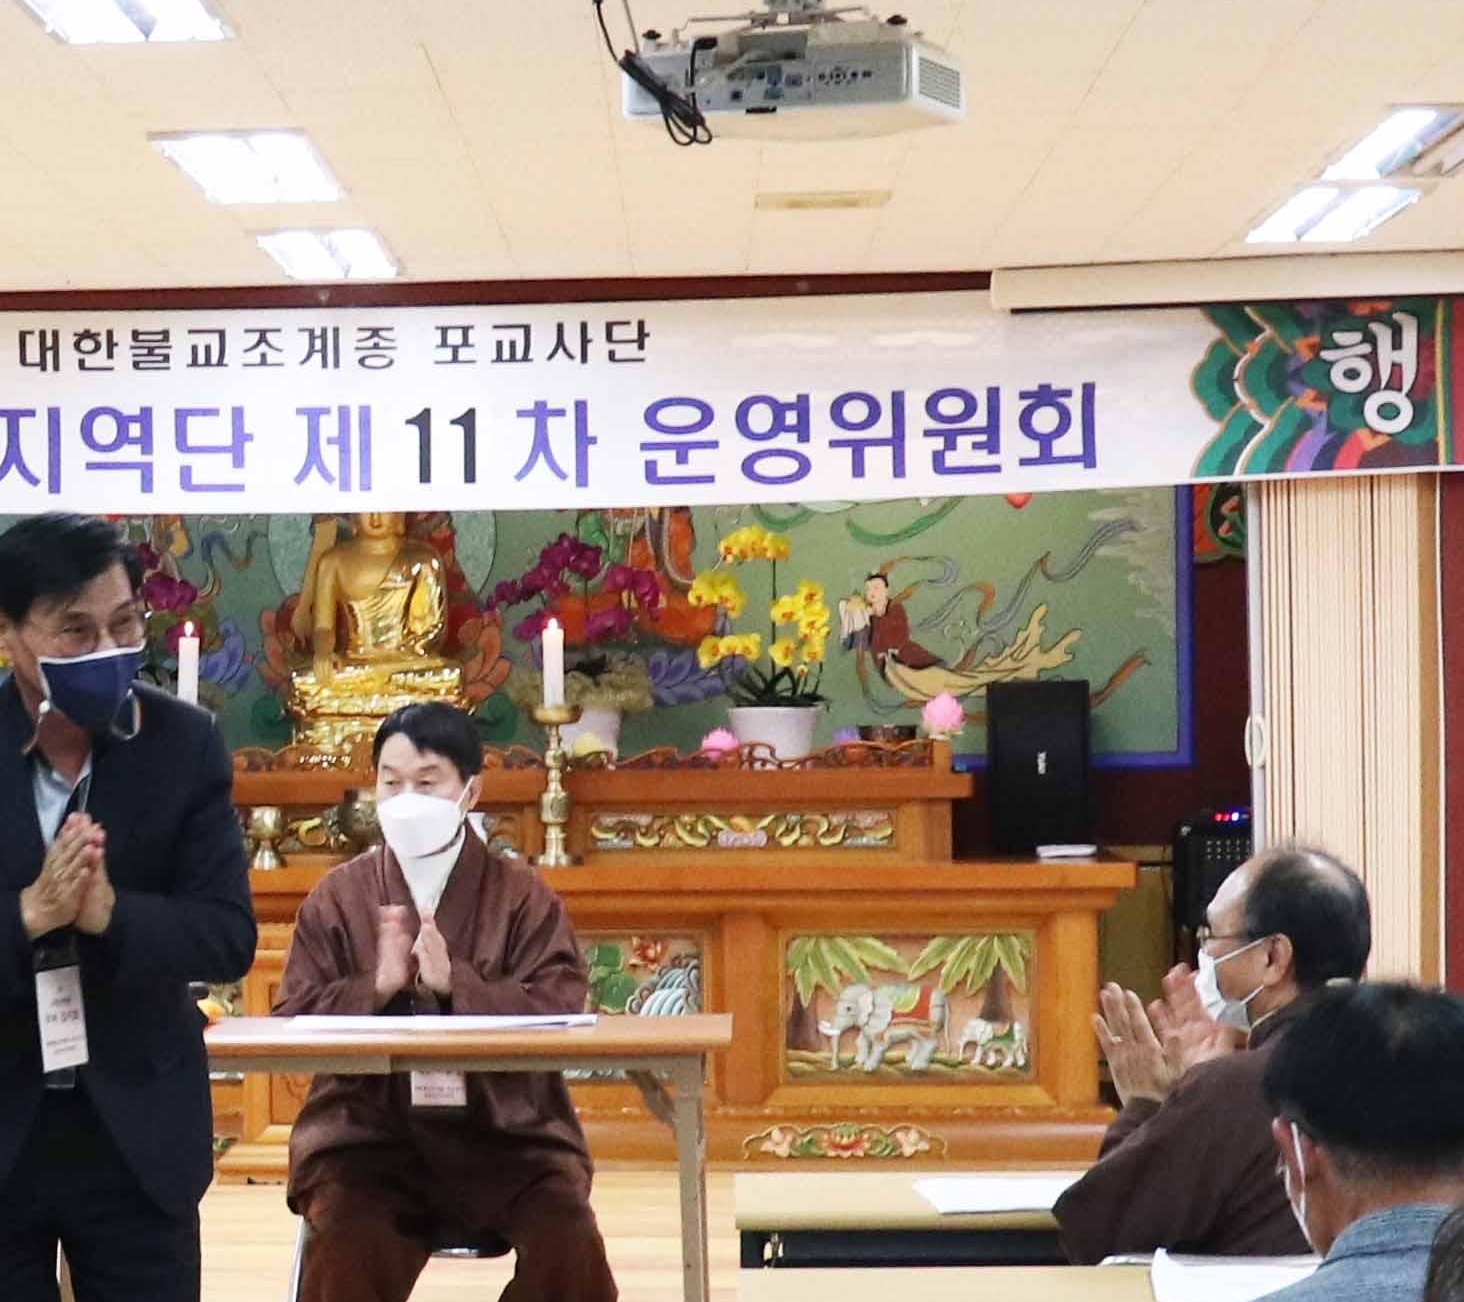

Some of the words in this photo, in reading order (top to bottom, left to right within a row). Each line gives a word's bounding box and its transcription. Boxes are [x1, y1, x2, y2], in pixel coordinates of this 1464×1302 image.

[18, 327, 394, 372] 대한불교조계종
[436, 319, 650, 364] 포교사단
[1318, 312, 1421, 435] 행
[639, 380, 1097, 487] 운영위원회
